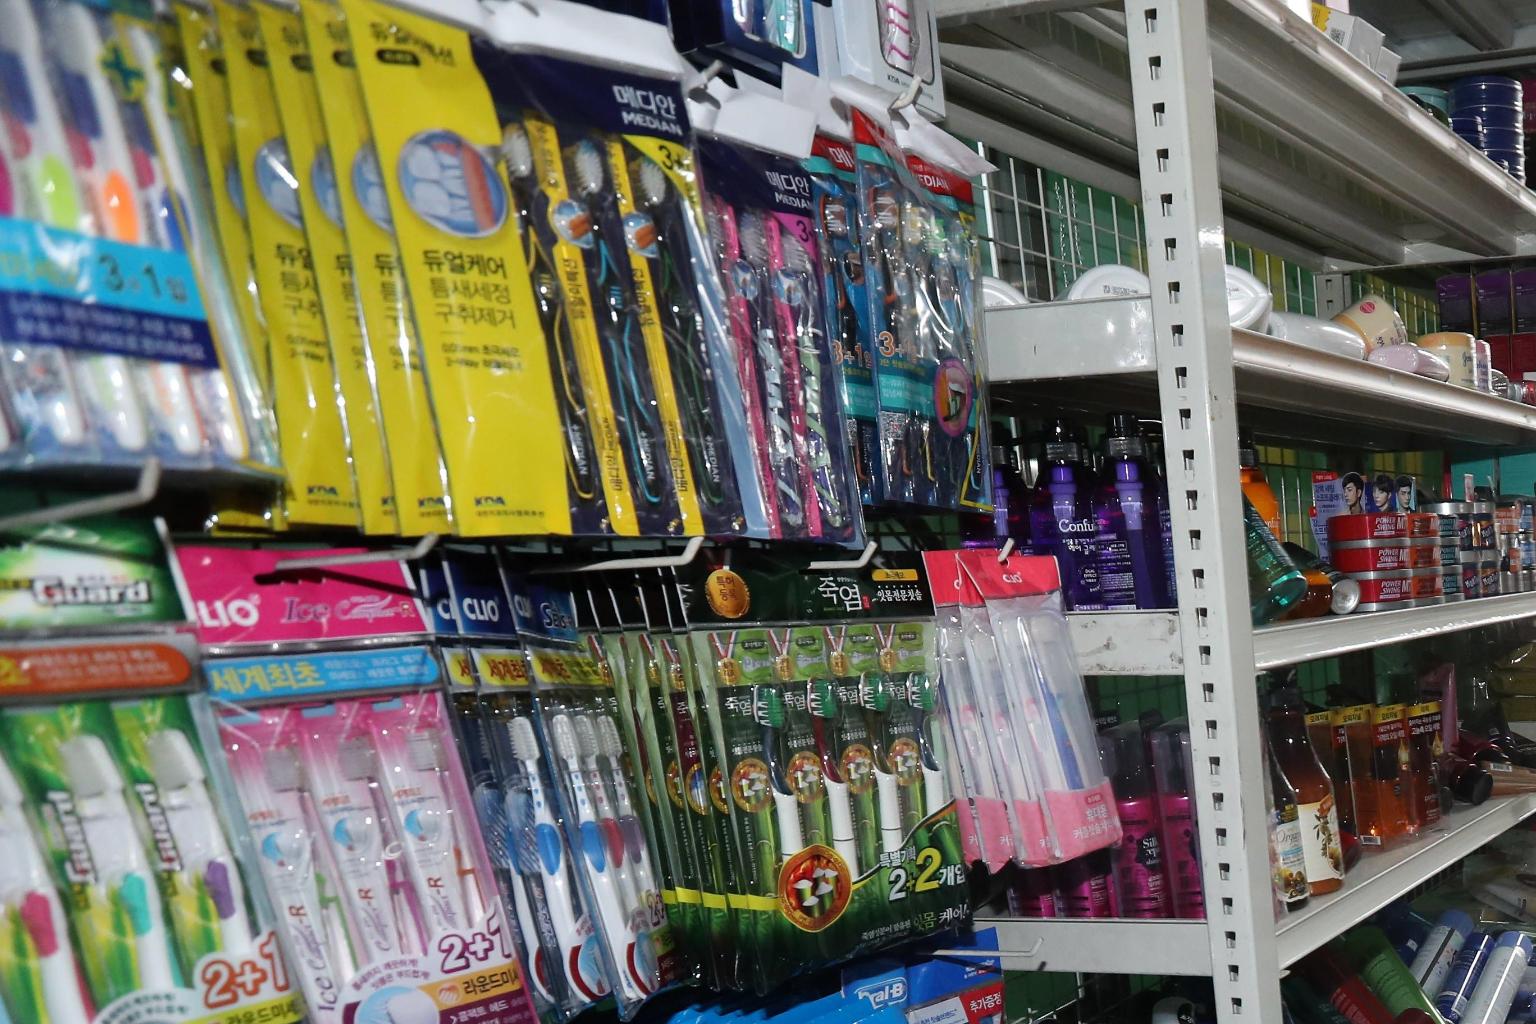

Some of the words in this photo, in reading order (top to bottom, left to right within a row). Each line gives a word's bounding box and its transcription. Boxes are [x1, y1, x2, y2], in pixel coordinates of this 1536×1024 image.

[612, 86, 676, 118] 메디안
[623, 112, 683, 136] MEDIAN
[765, 171, 810, 194] 메디안
[423, 249, 508, 279] 듀얼케어
[430, 277, 511, 304] 틈새세정
[435, 304, 516, 329] 구취제거
[1059, 519, 1094, 532] Confu
[1375, 516, 1396, 526] POWER
[1377, 523, 1397, 532] SWING
[1379, 550, 1399, 558] POWER
[1380, 555, 1399, 563] SWING
[818, 577, 863, 612] 죽염
[877, 588, 923, 603] 잇몸전문칫솔
[1381, 581, 1402, 589] POWER
[462, 597, 499, 622] CLIO
[211, 662, 324, 696] 세계최초
[203, 932, 290, 1010] 2+1
